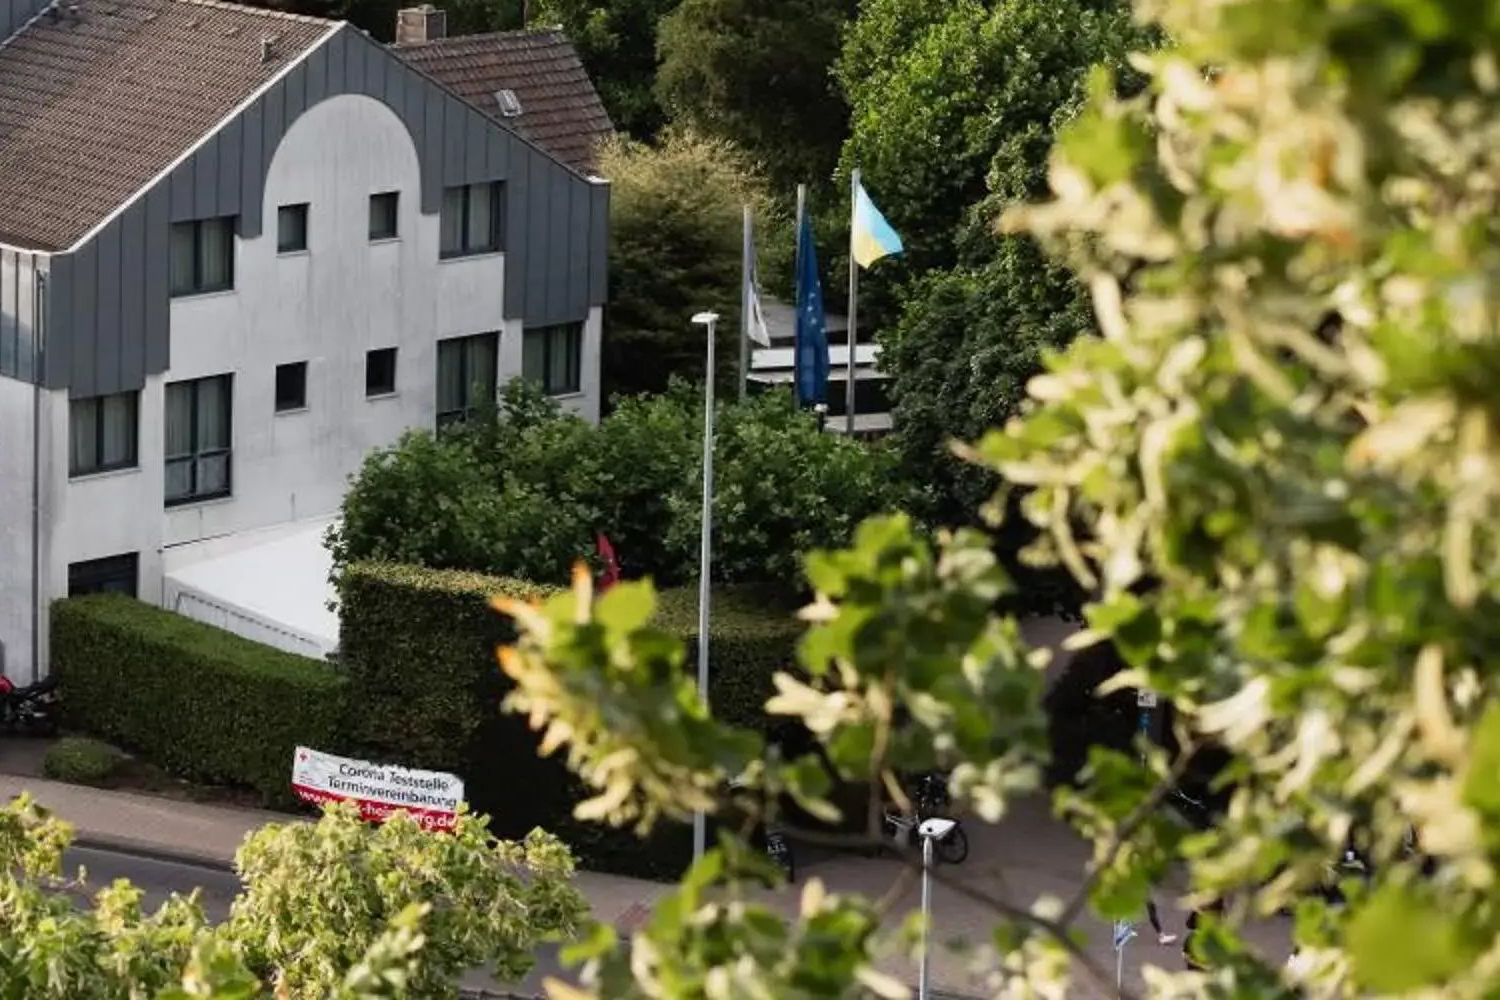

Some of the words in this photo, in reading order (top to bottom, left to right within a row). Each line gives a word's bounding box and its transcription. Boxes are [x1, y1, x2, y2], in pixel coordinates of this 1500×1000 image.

[328, 775, 458, 809] Terminvereinbarung
[339, 763, 385, 781] Corona
[390, 771, 449, 791] Teststelle
